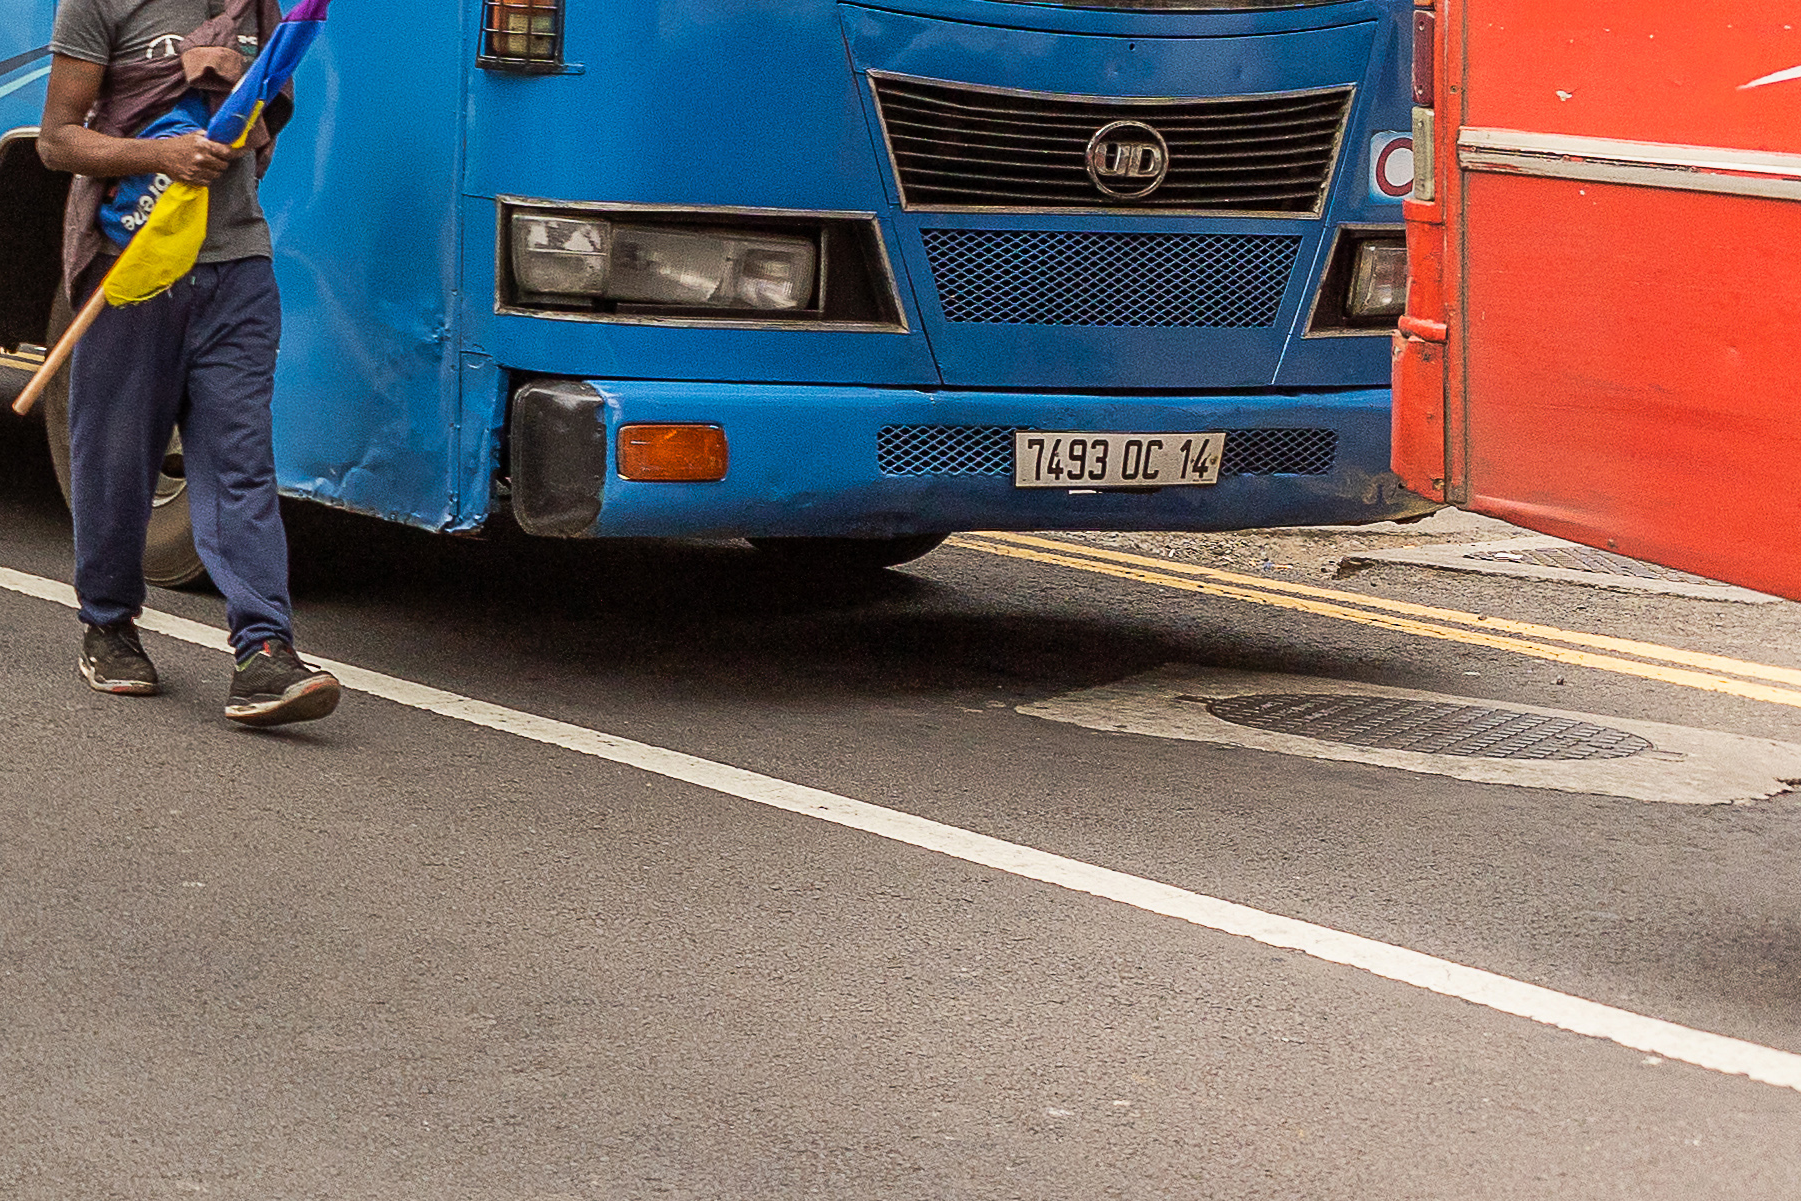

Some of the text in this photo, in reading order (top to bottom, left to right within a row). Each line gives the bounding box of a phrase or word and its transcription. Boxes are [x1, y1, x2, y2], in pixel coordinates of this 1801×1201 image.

[1094, 142, 1162, 178] UD
[1027, 438, 1109, 481] 7493
[1179, 438, 1211, 479] 14
